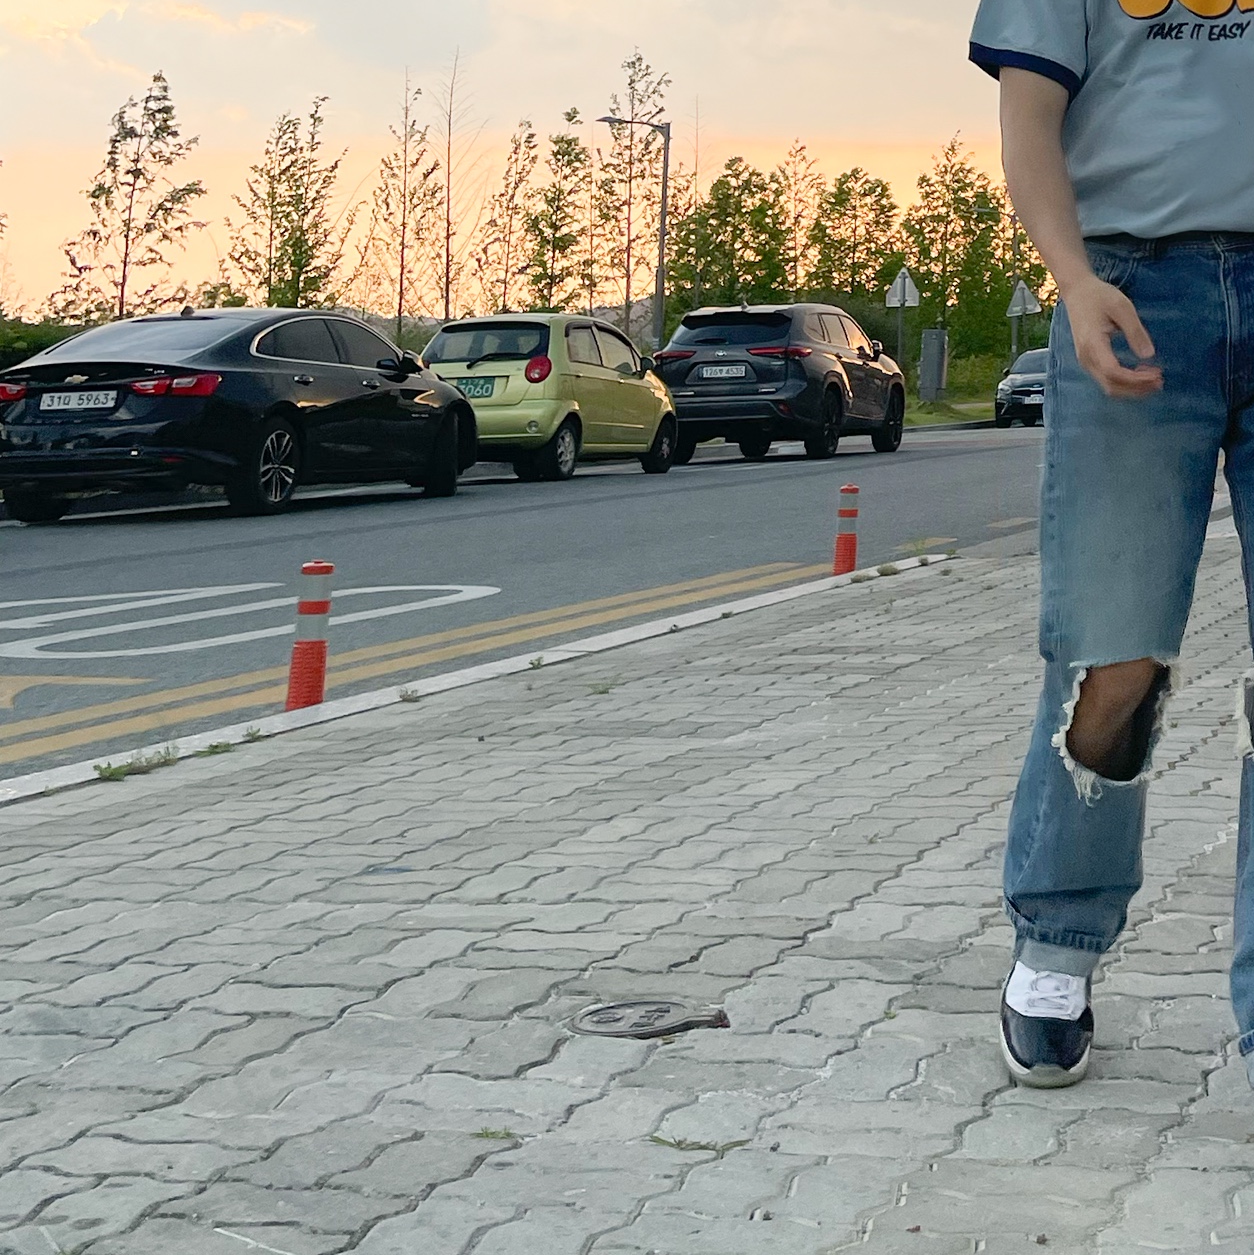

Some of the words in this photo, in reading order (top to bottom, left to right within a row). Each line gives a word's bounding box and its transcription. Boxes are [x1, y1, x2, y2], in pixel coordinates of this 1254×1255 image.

[1146, 22, 1189, 40] TAKE
[1190, 23, 1204, 39] IT
[1208, 21, 1251, 41] EASY
[77, 393, 109, 406] 5963
